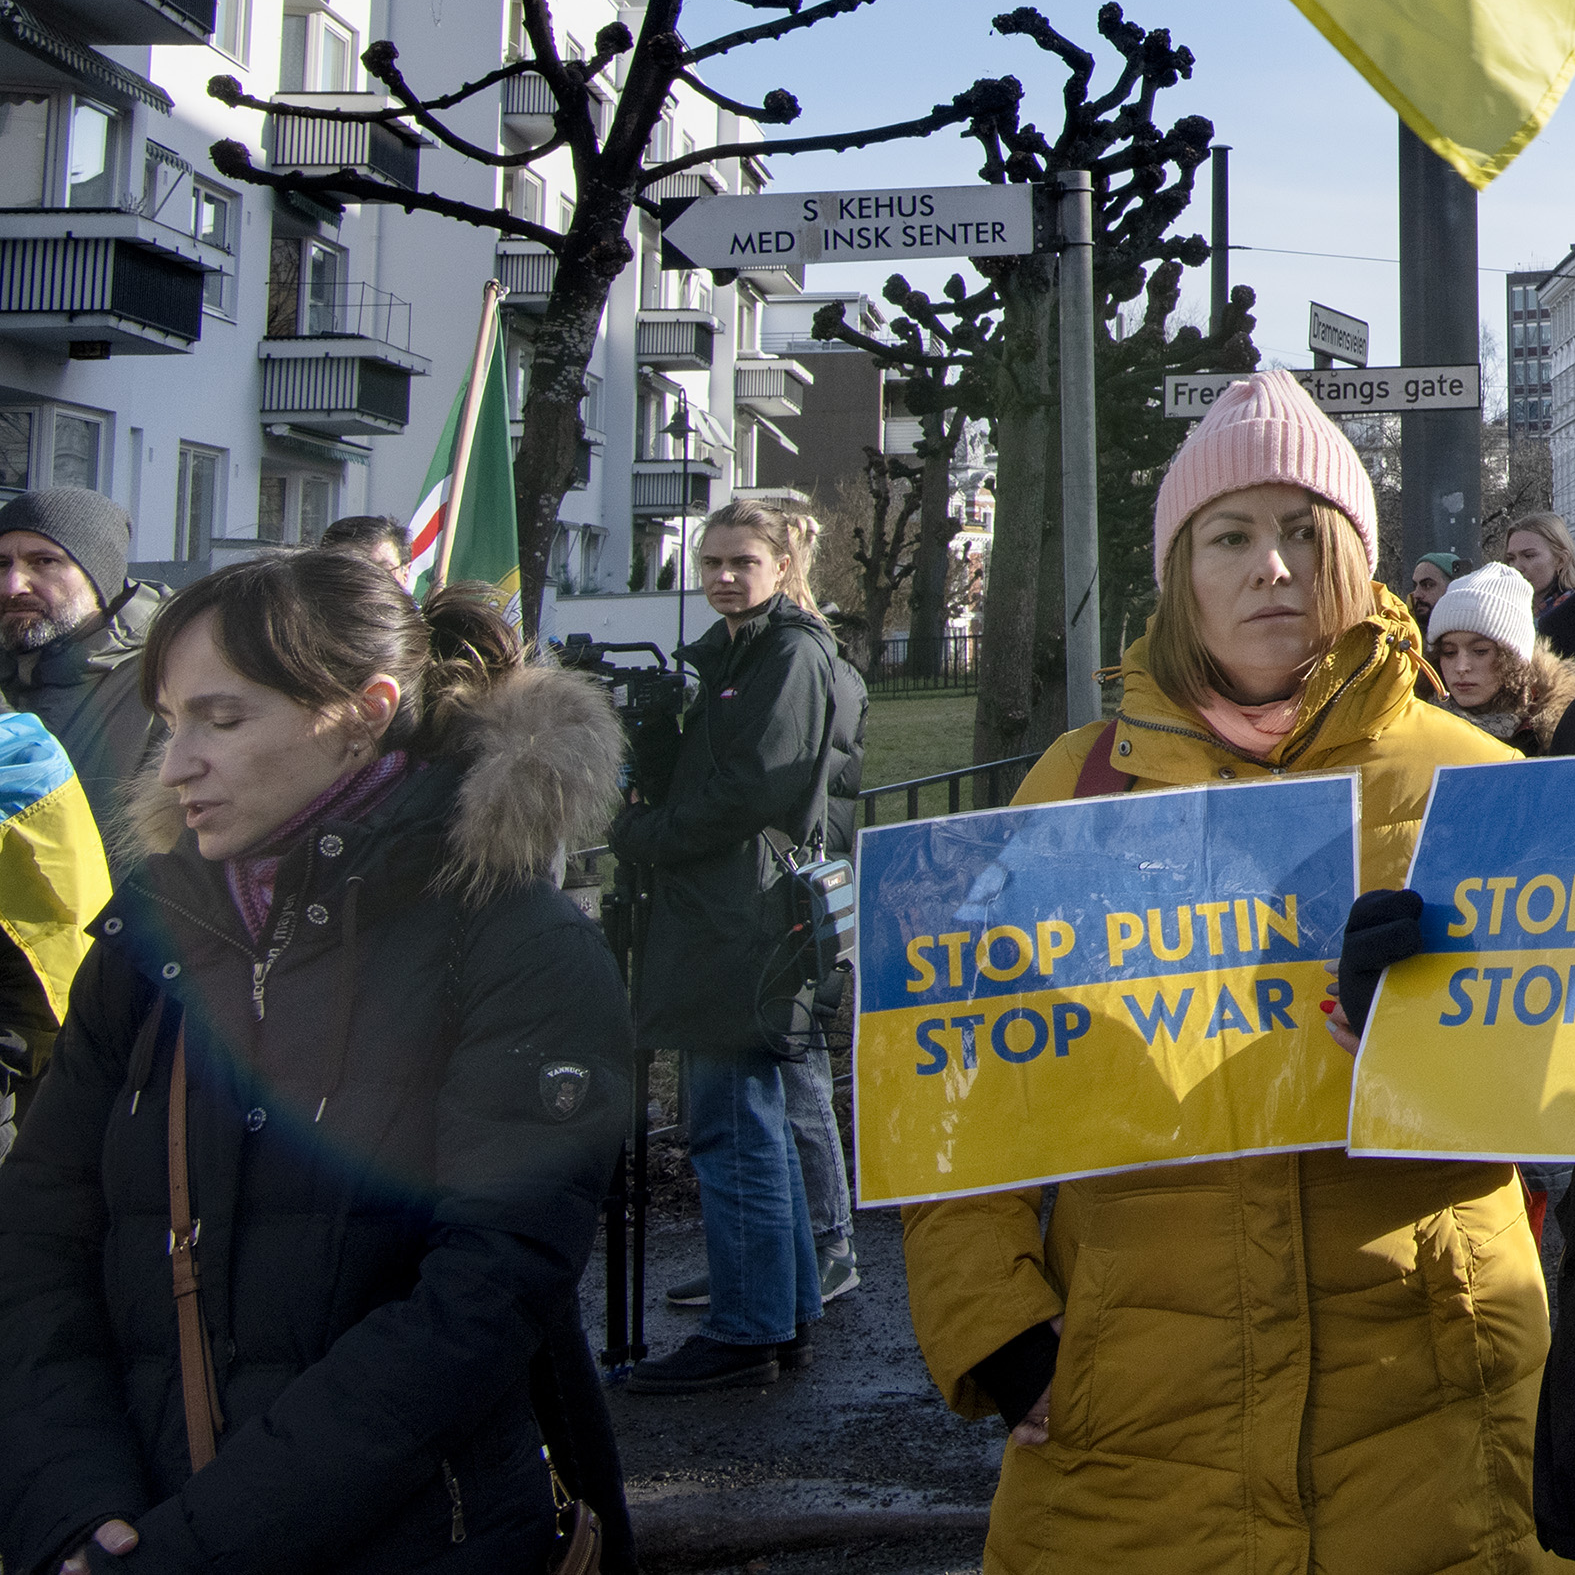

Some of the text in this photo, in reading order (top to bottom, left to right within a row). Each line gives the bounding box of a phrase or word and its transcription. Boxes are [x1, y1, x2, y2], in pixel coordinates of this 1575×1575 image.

[902, 221, 1007, 247] SENTER
[1313, 312, 1366, 357] Drammensveien
[1405, 375, 1464, 403] gate
[905, 893, 1300, 993] STOP PUTIN
[915, 978, 1298, 1076] STOP WAR
